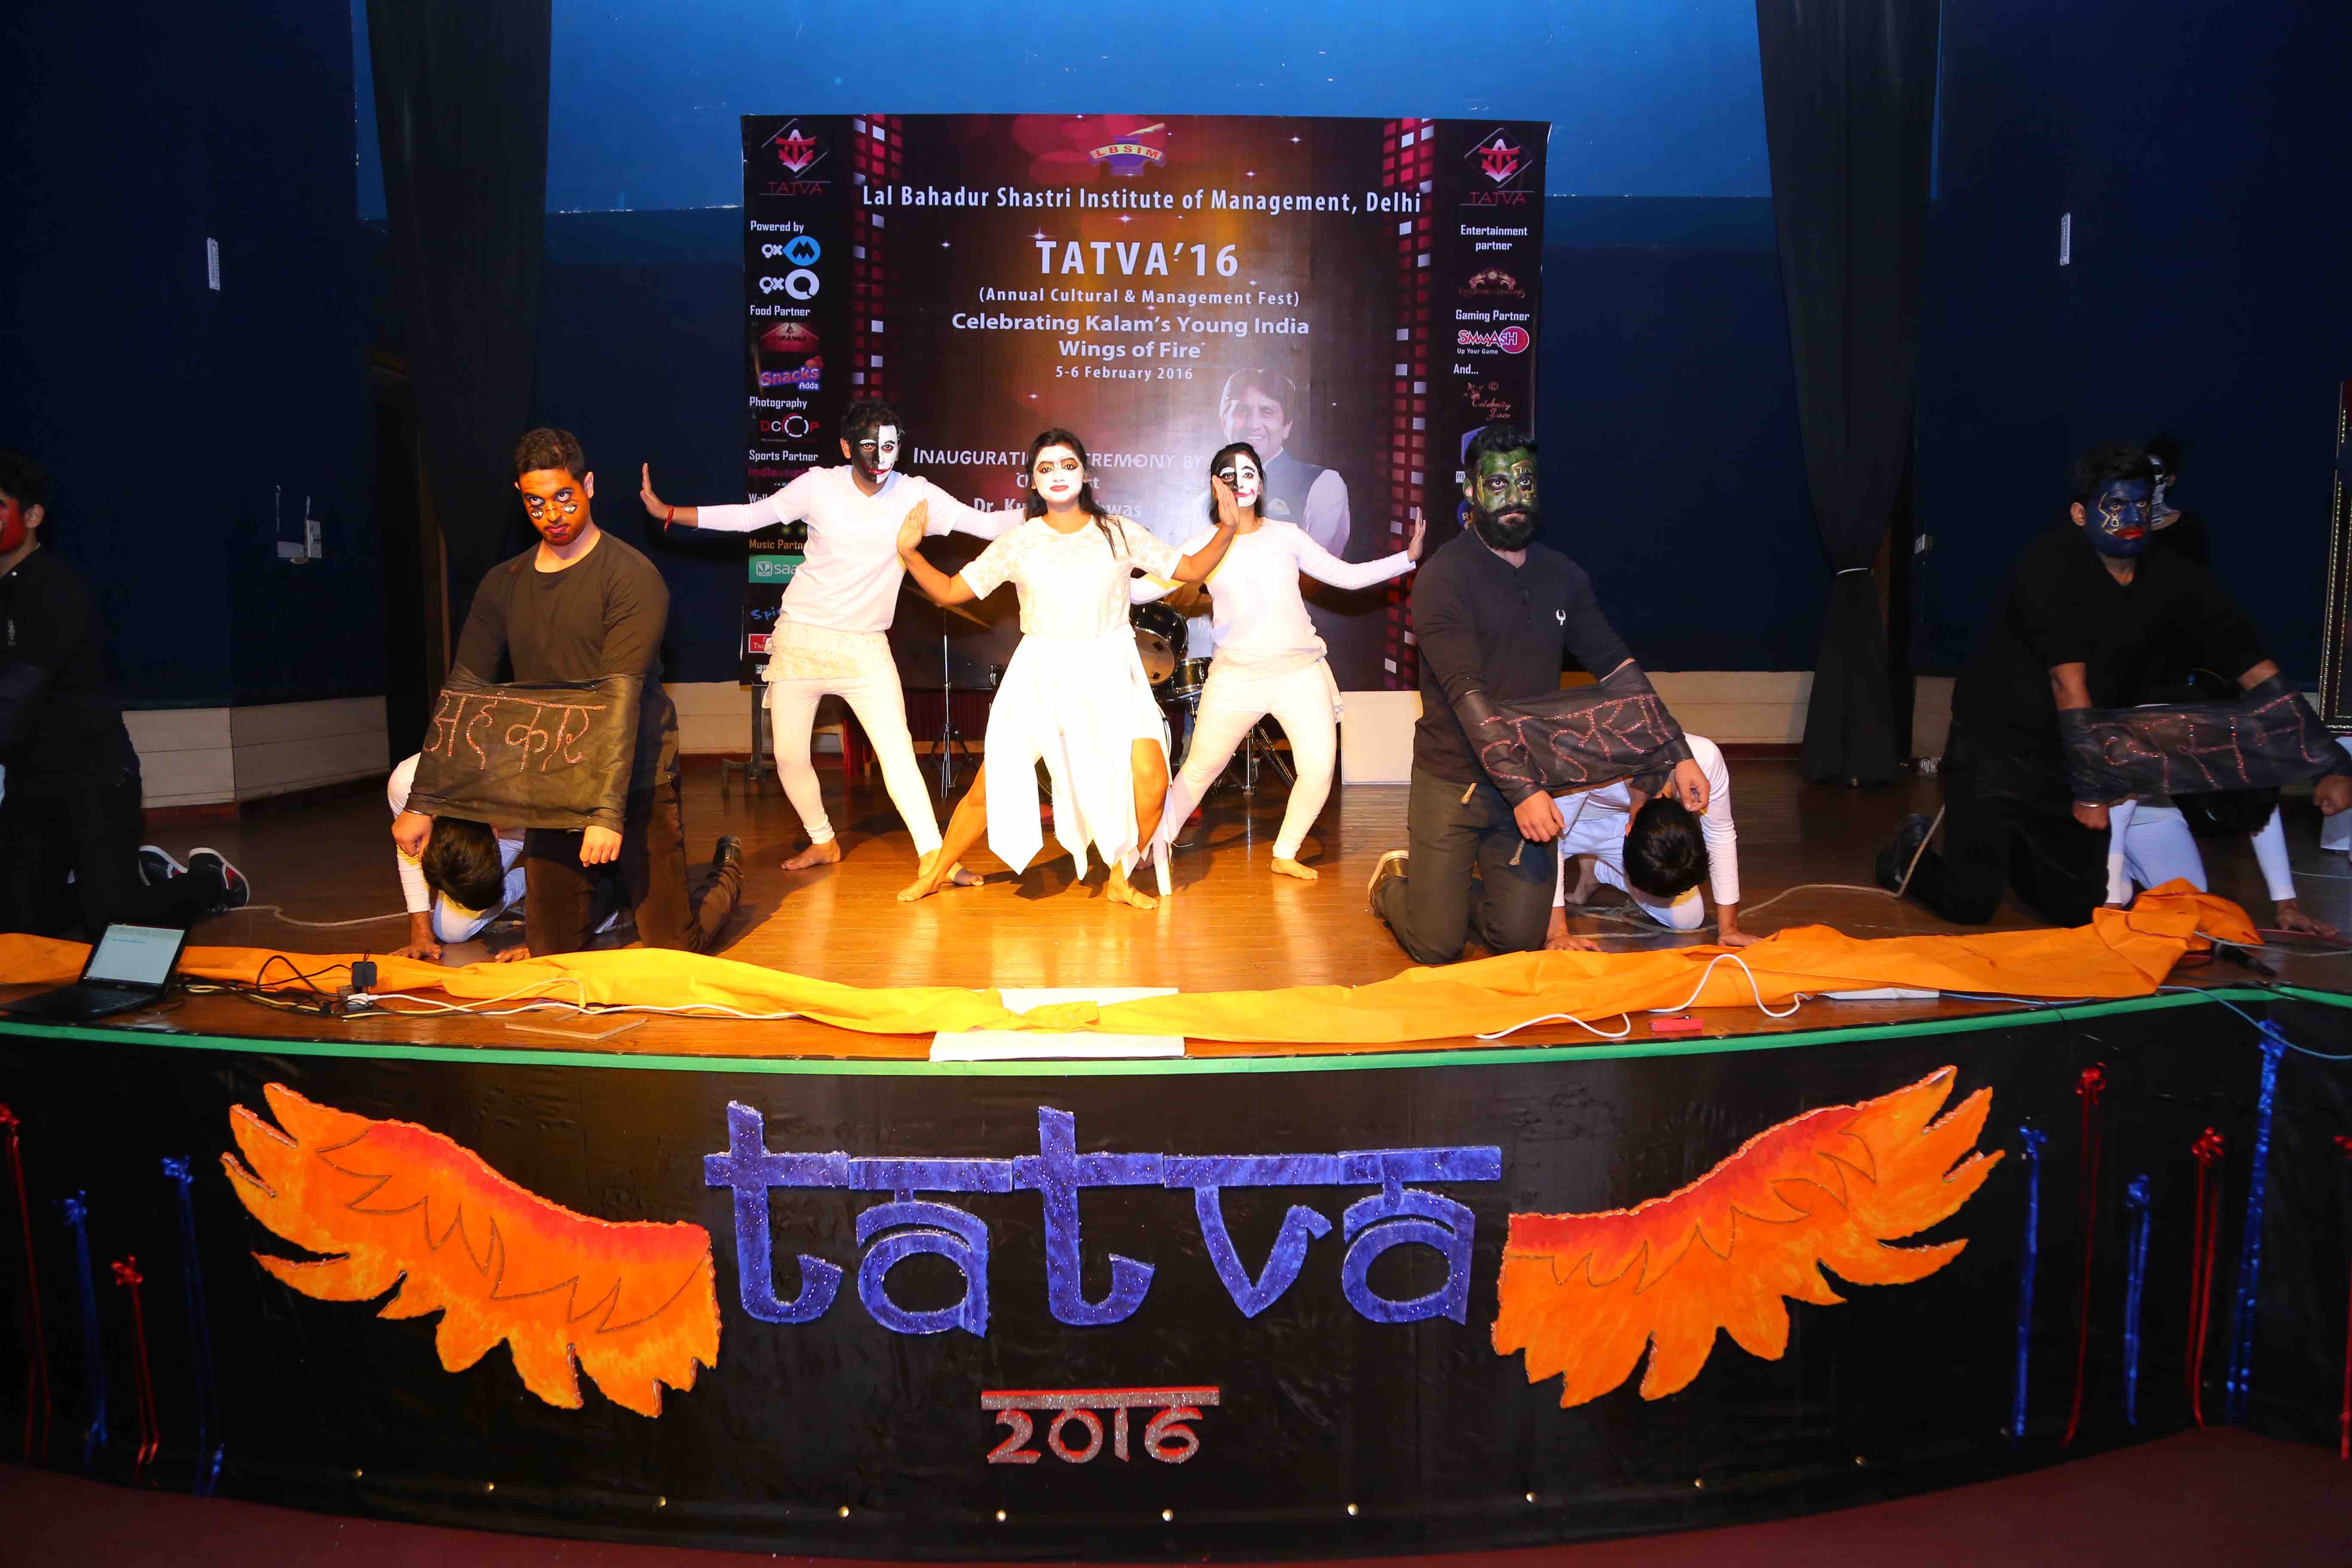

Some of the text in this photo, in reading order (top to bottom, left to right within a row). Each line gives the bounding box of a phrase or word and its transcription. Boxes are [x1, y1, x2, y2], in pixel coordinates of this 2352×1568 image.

[1096, 146, 1158, 158] LBSIM
[767, 182, 823, 195] TATVA
[863, 186, 1421, 215] Lal Bahadur Shastri Institute of Management, Delhi
[1470, 192, 1526, 204] TATVA
[750, 220, 804, 233] Powered by
[1461, 225, 1528, 236] Entertainment
[1476, 241, 1512, 252] partner
[980, 287, 1299, 307] (Annual Cultural & Management Fest)
[750, 305, 810, 316] Food Partner
[1456, 309, 1530, 322] Gaming Partner
[952, 313, 1079, 335] Celebrating
[1176, 316, 1248, 337] Young
[1255, 317, 1309, 334] India
[1059, 340, 1200, 361] Wings of Fire
[1056, 366, 1193, 381] 5-6 February 2016
[1453, 364, 1479, 374] And...
[760, 367, 819, 386] Snacks
[750, 396, 807, 409] Photography
[749, 450, 818, 462] Sports Partner
[913, 447, 1029, 466] INAUGURATI
[1183, 454, 1204, 468] BY
[750, 539, 804, 550] Music Partn
[774, 564, 797, 574] saa
[703, 1101, 1501, 1338] tatva
[981, 1386, 1220, 1464] 2016
